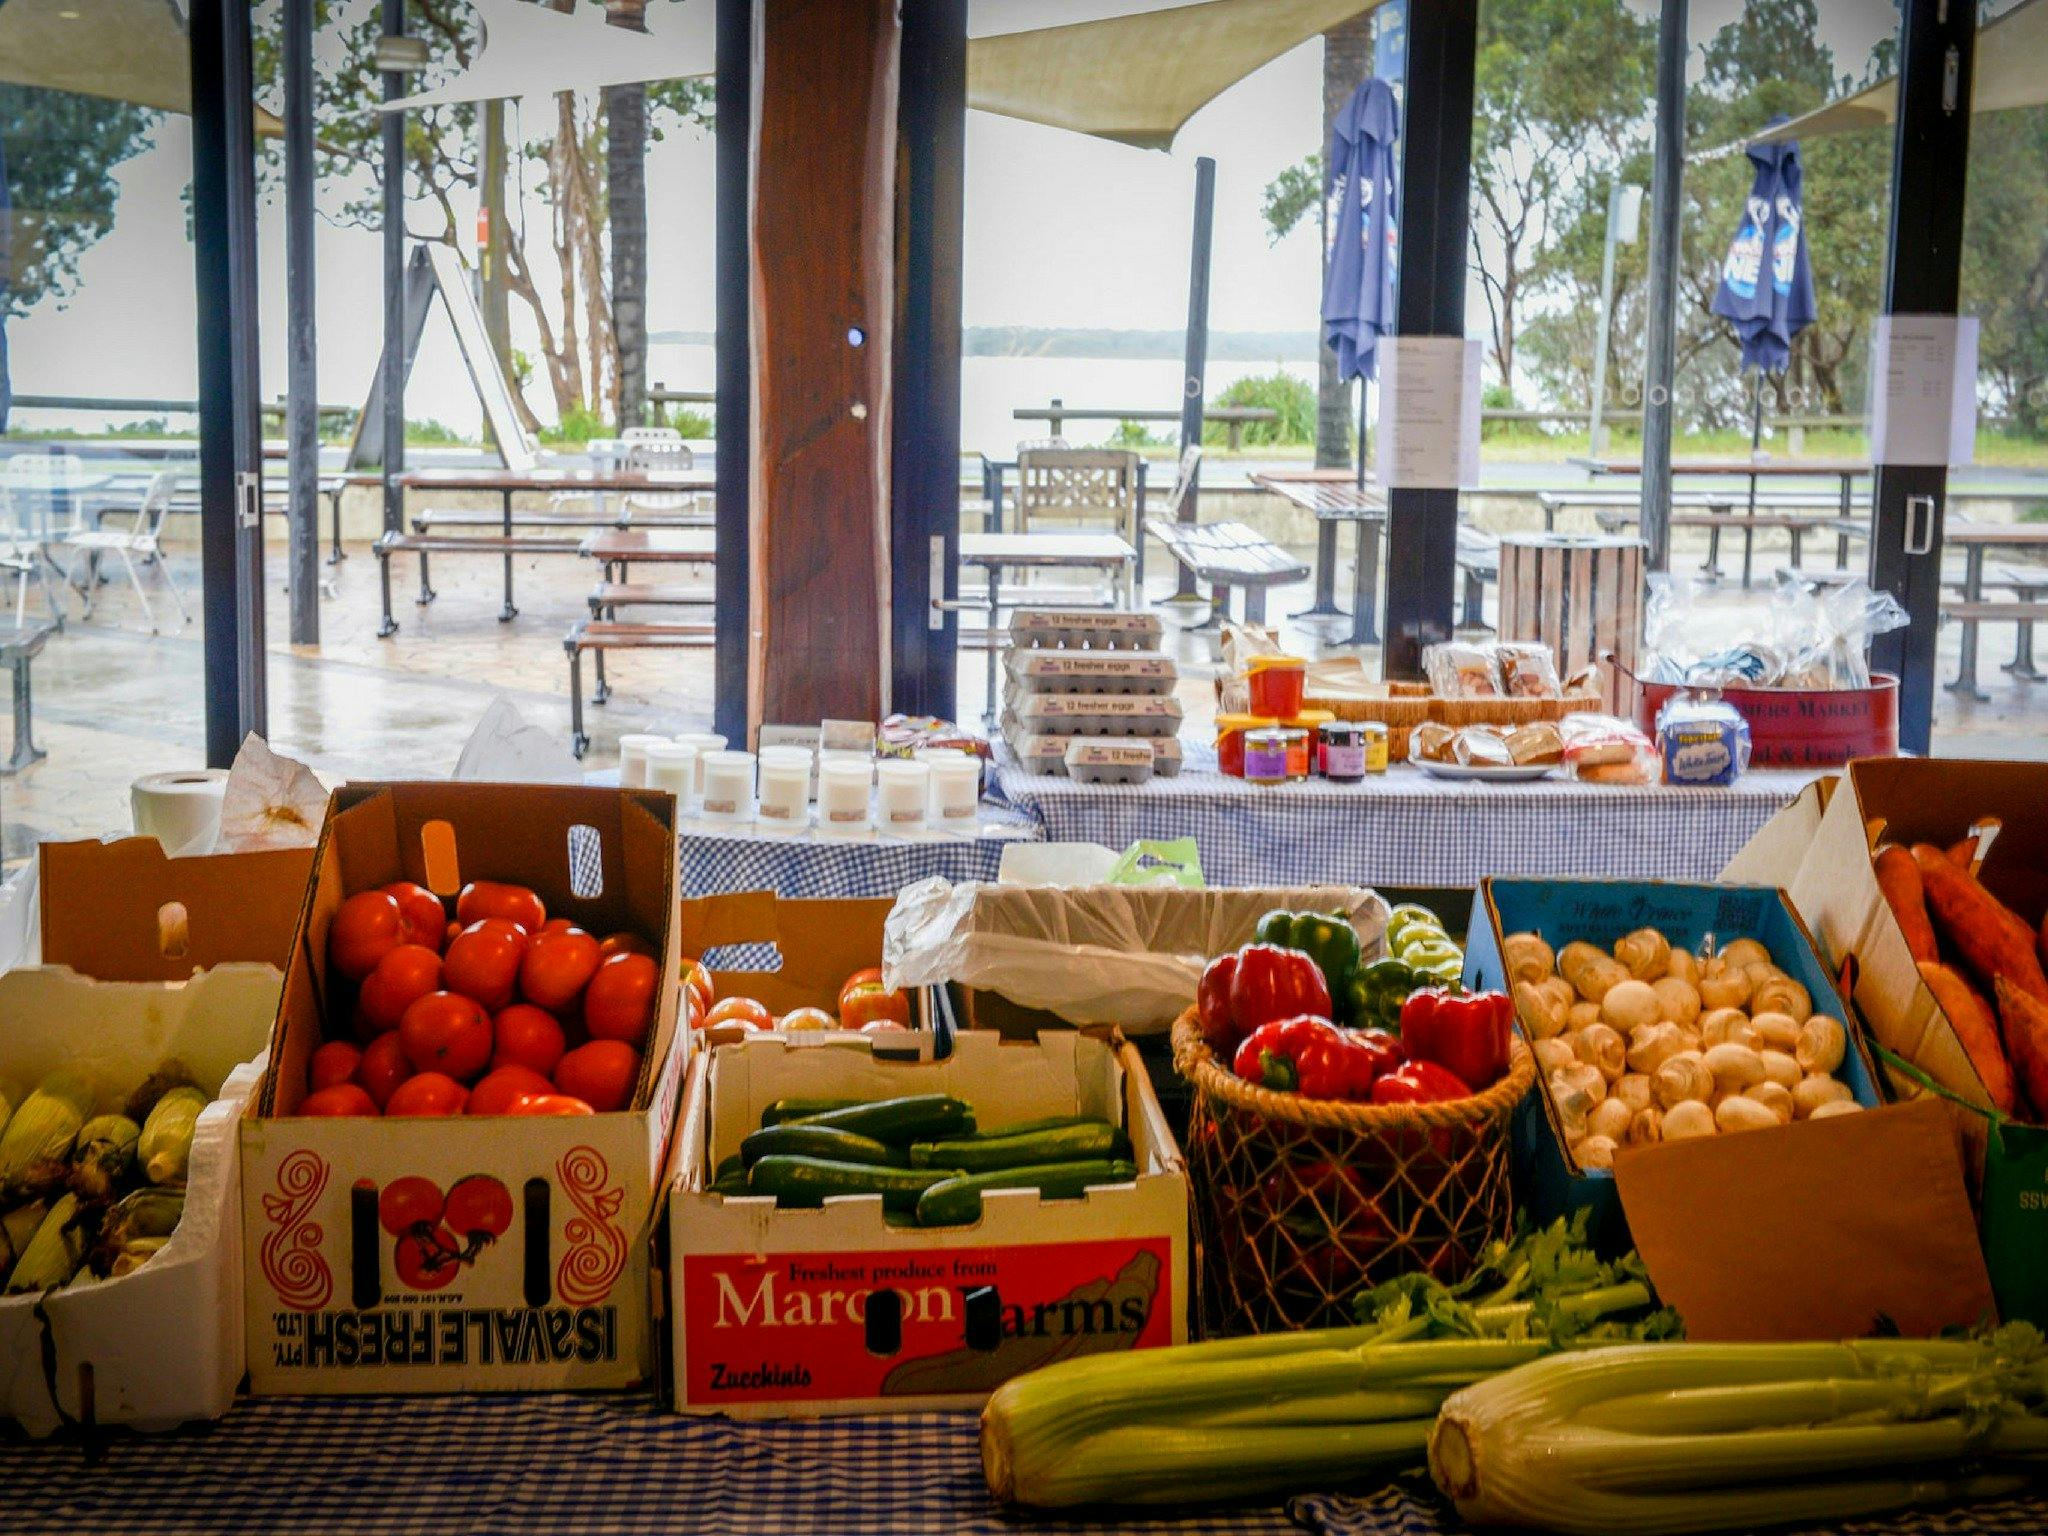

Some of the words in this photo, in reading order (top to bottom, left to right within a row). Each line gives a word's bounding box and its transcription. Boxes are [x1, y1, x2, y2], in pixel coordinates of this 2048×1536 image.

[1063, 615, 1093, 625] fresher
[1095, 617, 1118, 626] eggs
[1063, 660, 1072, 670] 12
[1074, 660, 1105, 671] fresher
[1107, 662, 1132, 672] eggs
[1066, 701, 1075, 710] 12
[1077, 700, 1109, 710] fresher
[1112, 702, 1136, 712] eggs
[789, 1261, 866, 1283] Freshest
[872, 1260, 945, 1285] produce
[953, 1259, 998, 1276] from
[957, 1284, 1146, 1341] arms
[709, 1362, 812, 1391] Zucchinis
